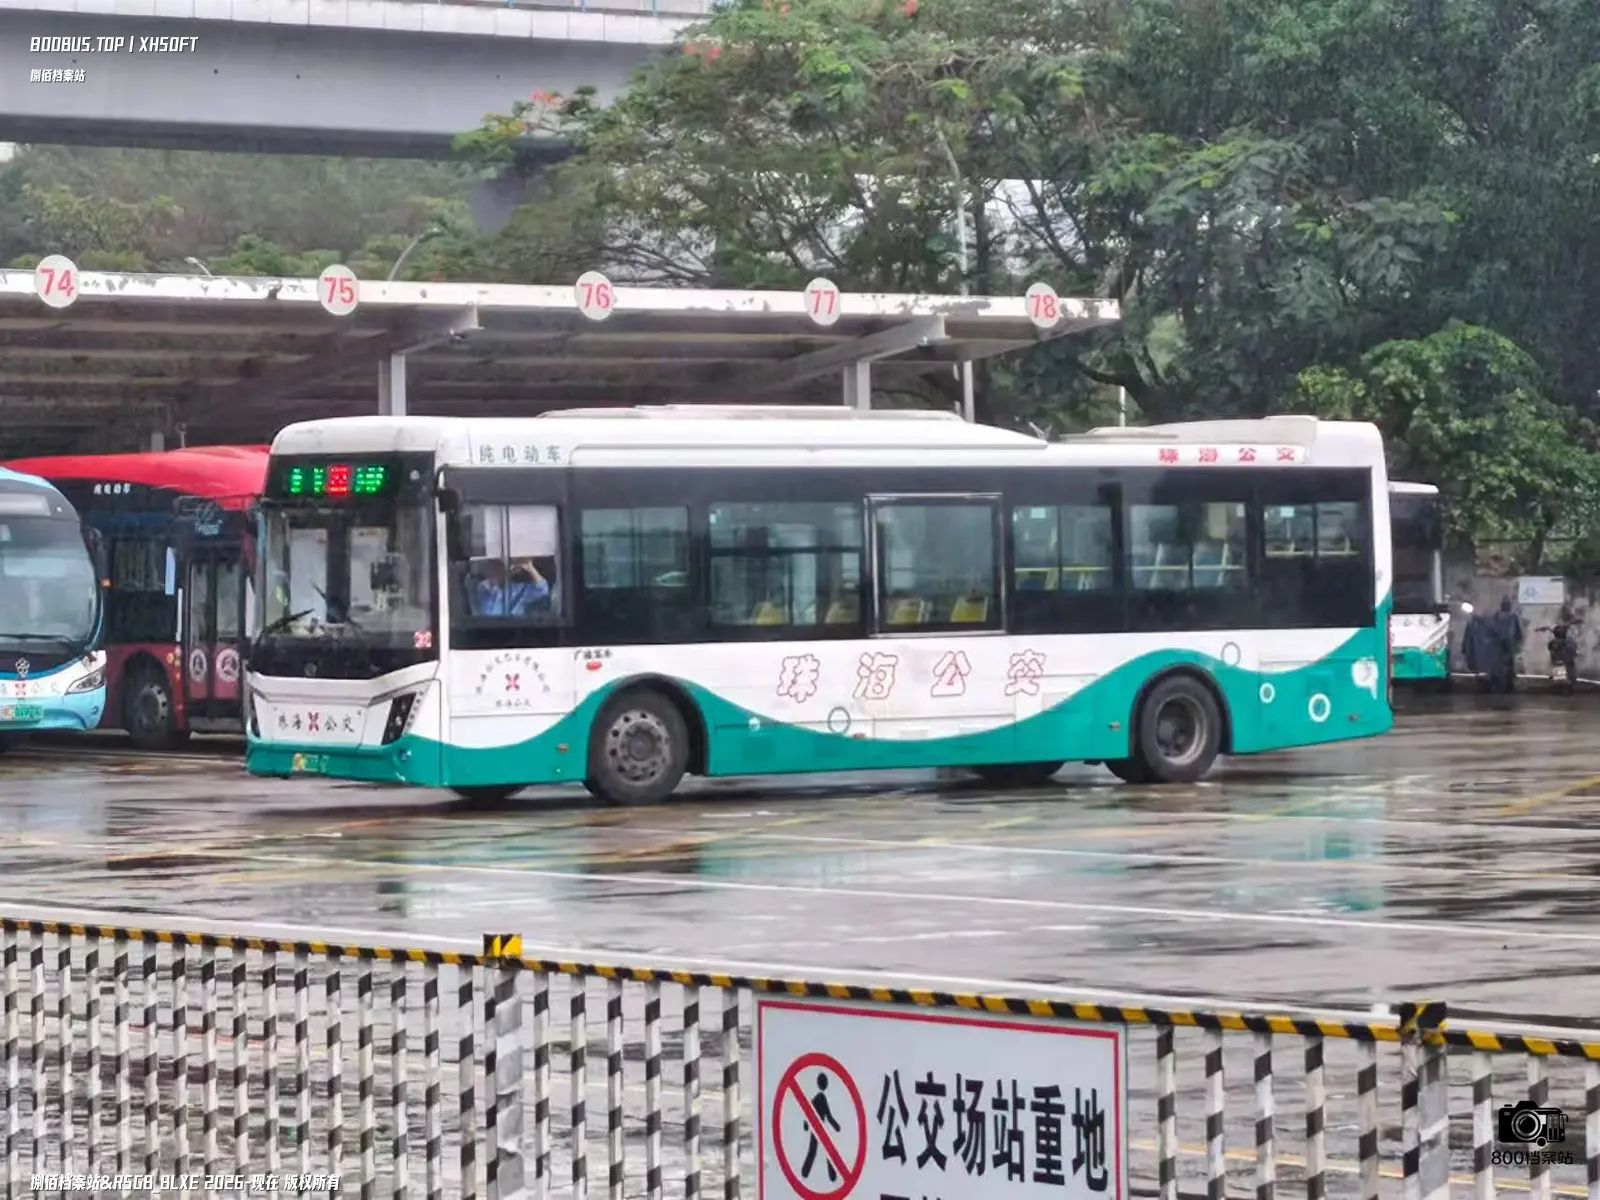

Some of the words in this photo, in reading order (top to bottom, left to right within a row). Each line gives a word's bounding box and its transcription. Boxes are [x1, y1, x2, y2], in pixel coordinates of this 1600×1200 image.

[40, 268, 75, 297] 74
[323, 276, 354, 304] 75
[581, 283, 610, 309] 76
[810, 290, 836, 315] 77
[1031, 294, 1056, 318] 78
[479, 445, 562, 463] 纯电动车
[876, 1069, 1109, 1192] 公交场站重地
